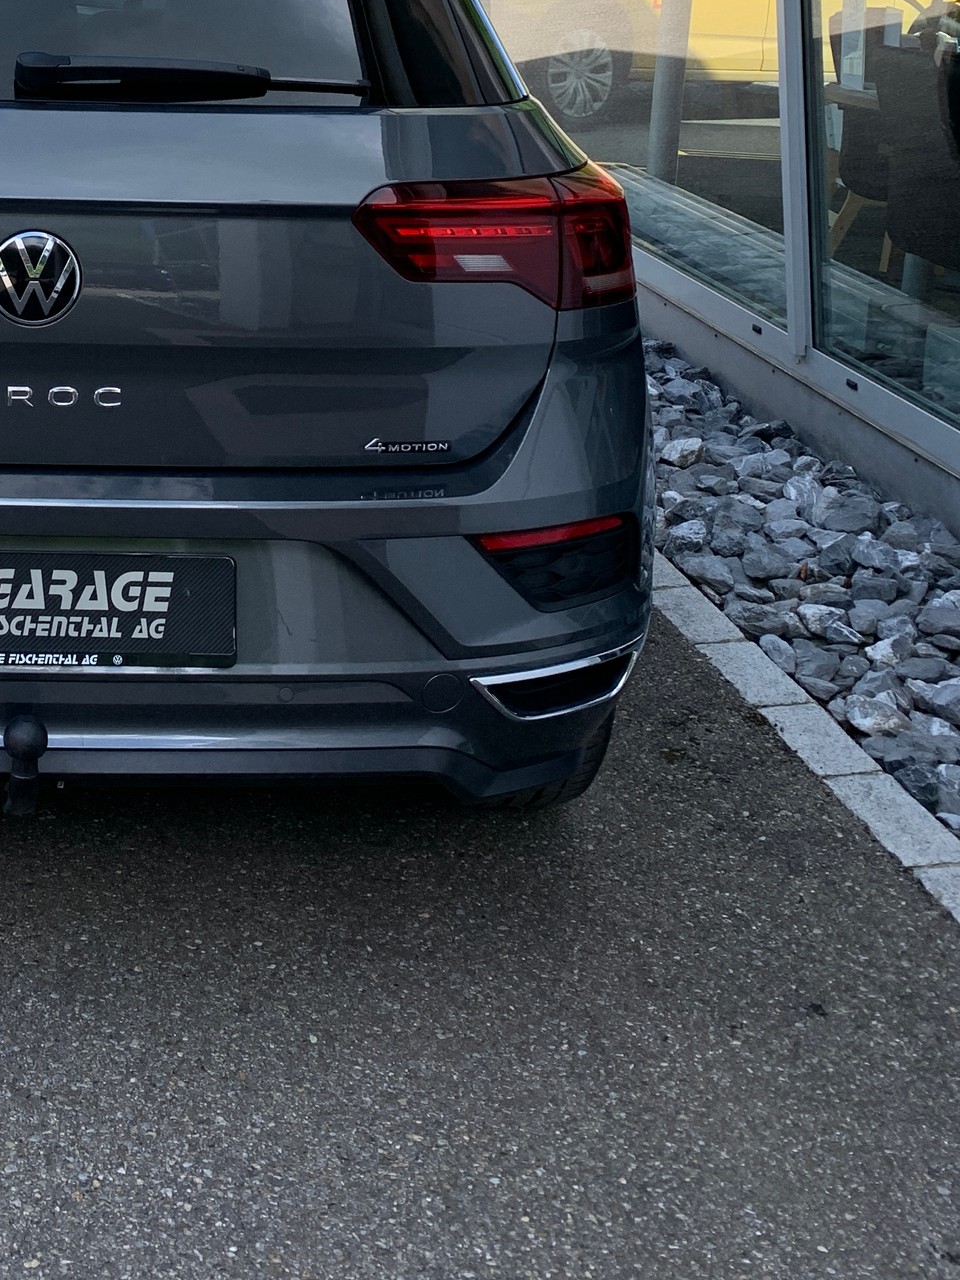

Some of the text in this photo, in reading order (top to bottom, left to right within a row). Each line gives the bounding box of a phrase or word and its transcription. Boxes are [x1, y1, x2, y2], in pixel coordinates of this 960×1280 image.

[364, 437, 449, 454] 4MOTION
[131, 618, 167, 640] AG
[8, 653, 79, 665] FISCHENTHAL
[81, 654, 99, 666] AG
